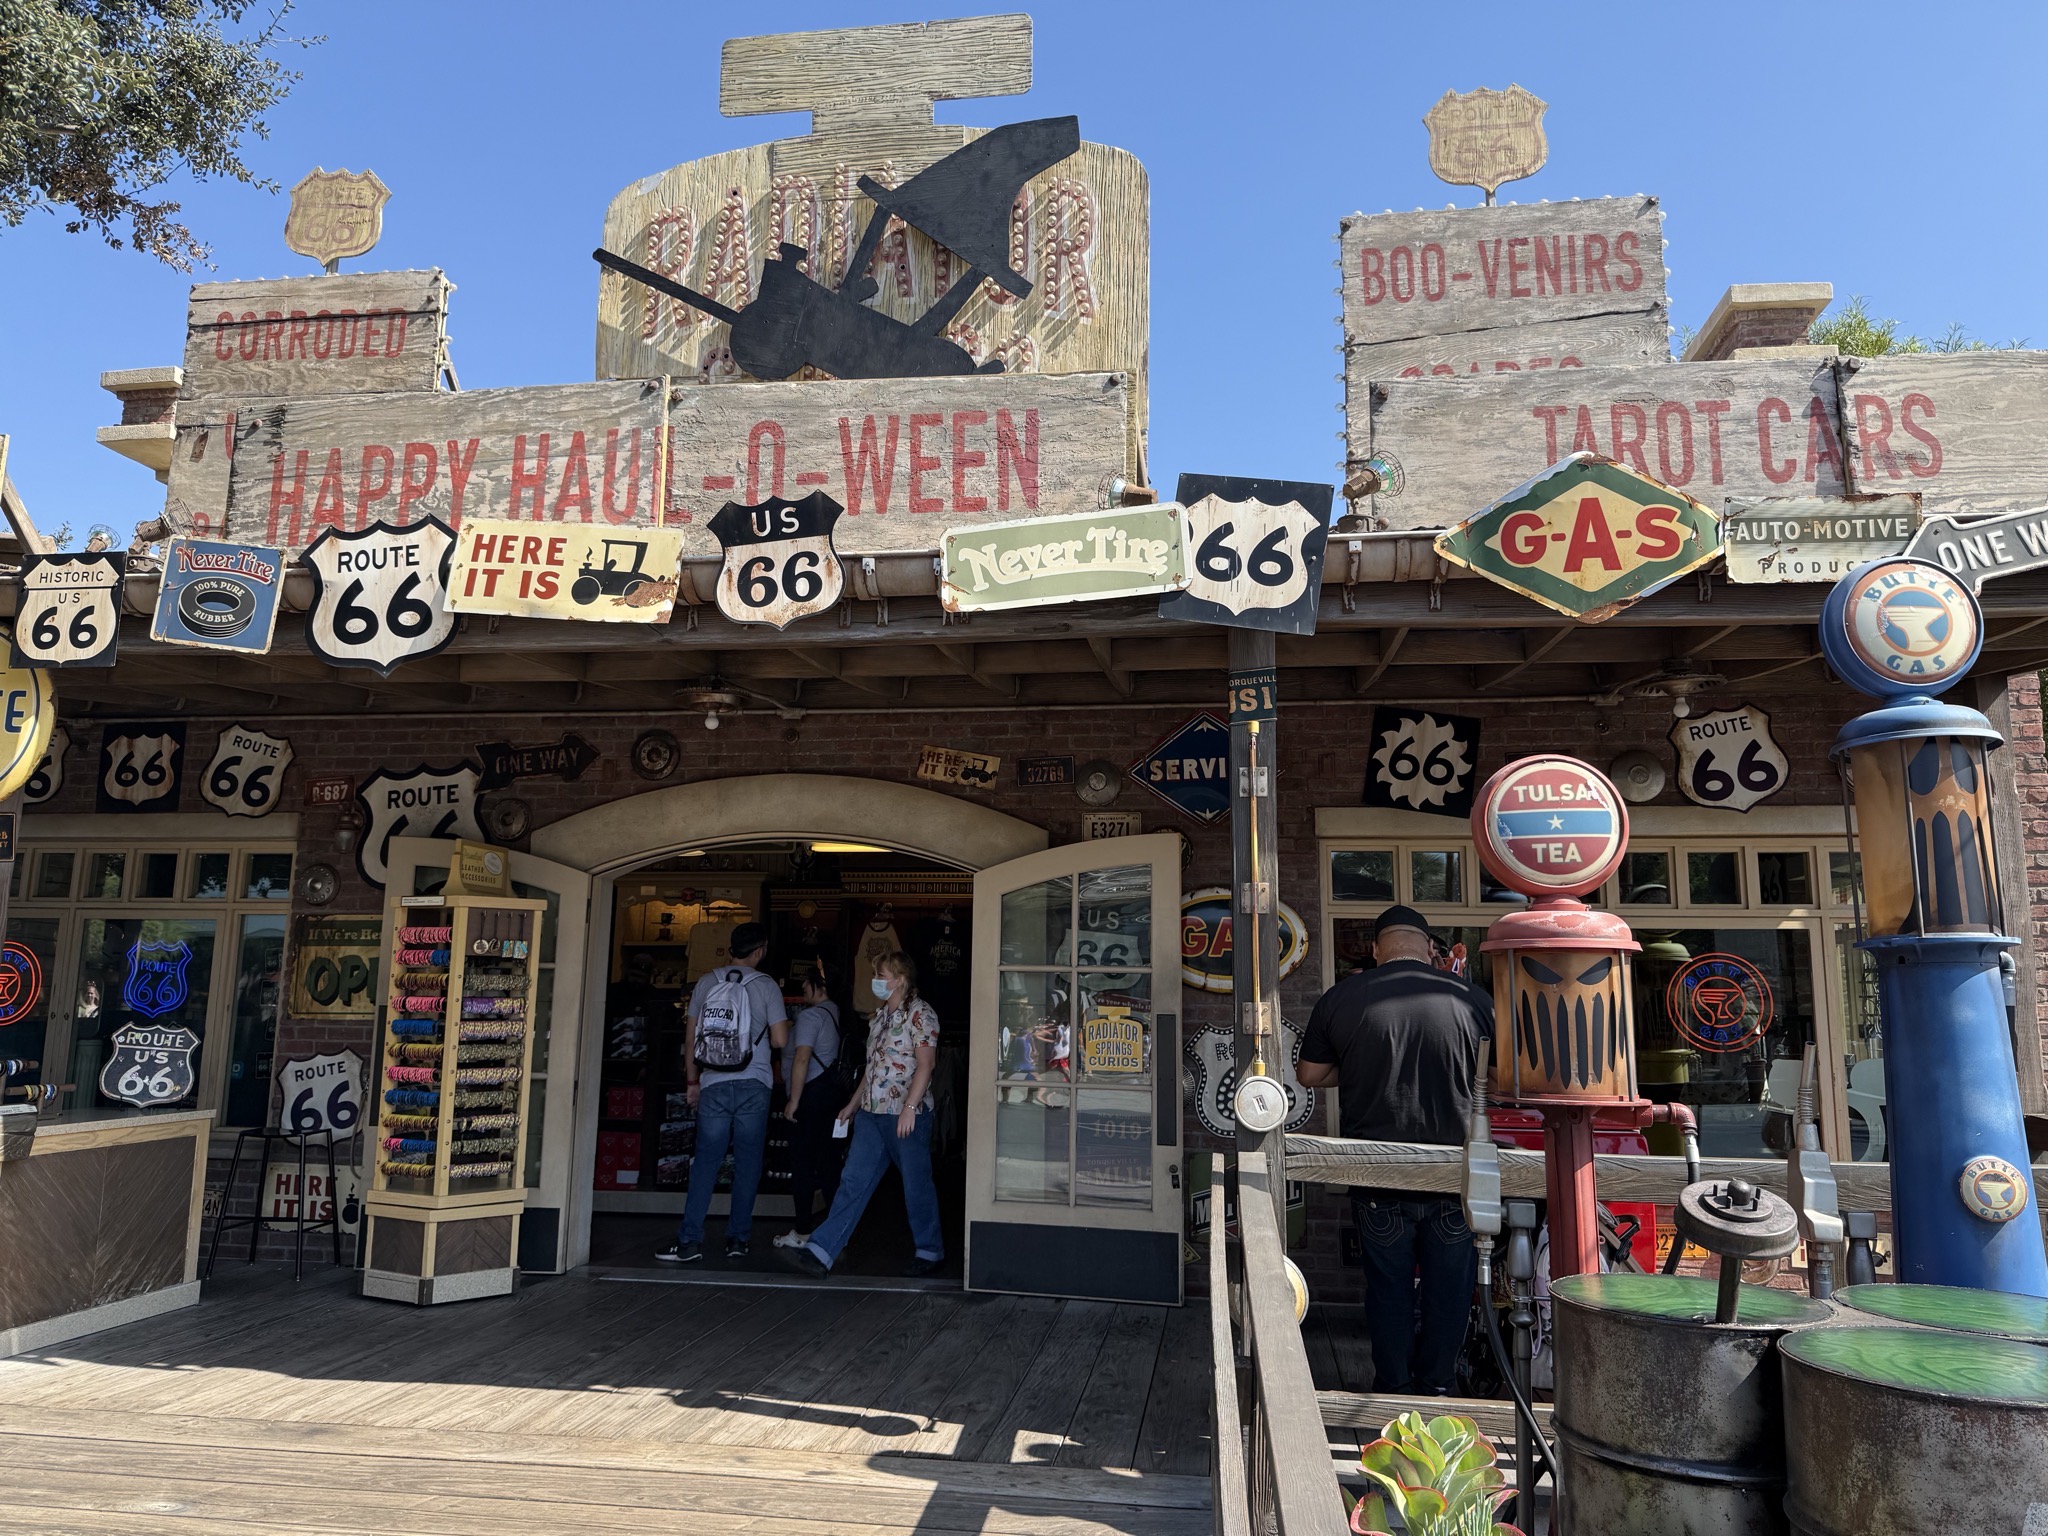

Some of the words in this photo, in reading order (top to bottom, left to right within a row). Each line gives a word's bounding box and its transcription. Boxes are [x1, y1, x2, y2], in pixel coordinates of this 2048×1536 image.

[312, 185, 365, 199] ROUTE
[304, 212, 356, 244] 66
[1361, 231, 1644, 307] BOO-VENIRS
[215, 306, 408, 361] CORRODED
[1533, 399, 1731, 488] TAROT
[1756, 392, 1943, 485] CARS
[266, 436, 480, 547] HAPPY
[751, 506, 800, 537] US
[1736, 517, 1909, 541] AUTO-MOTIVE
[1500, 496, 1682, 573] G-A-S
[337, 543, 420, 574] ROUTE
[470, 533, 568, 567] HERE
[959, 537, 1083, 592] Never
[1086, 525, 1169, 576] Tire
[1195, 520, 1294, 587] 66
[1937, 529, 2014, 574] ONE
[175, 547, 236, 573] Never
[237, 550, 275, 579] Tire
[1761, 560, 1871, 574] PRODUC
[39, 570, 104, 583] HISTORIC
[463, 568, 504, 598] IT
[518, 570, 561, 600] IS
[737, 551, 823, 608] 66
[58, 592, 81, 604] US
[194, 580, 219, 593] 100%
[220, 581, 246, 598] PURE
[193, 609, 236, 623] RUBBER
[332, 571, 433, 646] 66
[32, 605, 98, 650] 66
[1886, 654, 1946, 675] GAS
[1229, 675, 1277, 687] ORQUEVILL
[1688, 715, 1753, 741] ROUTE
[232, 734, 280, 759] ROUTE
[115, 751, 167, 788] 66
[495, 753, 532, 774] ONE
[538, 747, 580, 770] WAY
[923, 764, 937, 775] IT
[926, 751, 961, 767] HERE
[1149, 757, 1228, 782] SERVI
[1387, 736, 1455, 786] 66
[1692, 738, 1779, 801] 66
[209, 755, 274, 808] 66
[1027, 765, 1064, 783] 32769
[387, 784, 459, 809] ROUTE
[1513, 783, 1590, 804] TULSA
[1532, 842, 1582, 864] TEA
[461, 864, 485, 874] LEATHER
[461, 873, 496, 885] ACCESSORIES
[1087, 909, 1120, 931] US
[308, 928, 320, 940] If
[140, 959, 178, 974] ROUTE
[1070, 939, 1130, 979] 66
[133, 973, 178, 1006] 66
[127, 1030, 186, 1049] ROUTE
[1088, 1021, 1139, 1044] RADIATOR
[1699, 1025, 1743, 1042] GAS
[134, 1050, 170, 1065] US
[1095, 1042, 1132, 1056] SPRINGS
[295, 1061, 346, 1082] ROUTE
[1088, 1055, 1139, 1068] CURIOS
[118, 1064, 175, 1099] 66
[290, 1080, 359, 1132] 66
[1093, 1119, 1142, 1141] 1019
[1966, 1161, 2019, 1181] BUTTE
[204, 1199, 220, 1217] 4N
[273, 1199, 300, 1220] IT
[309, 1200, 334, 1221] IS
[1979, 1208, 2013, 1219] GAS
